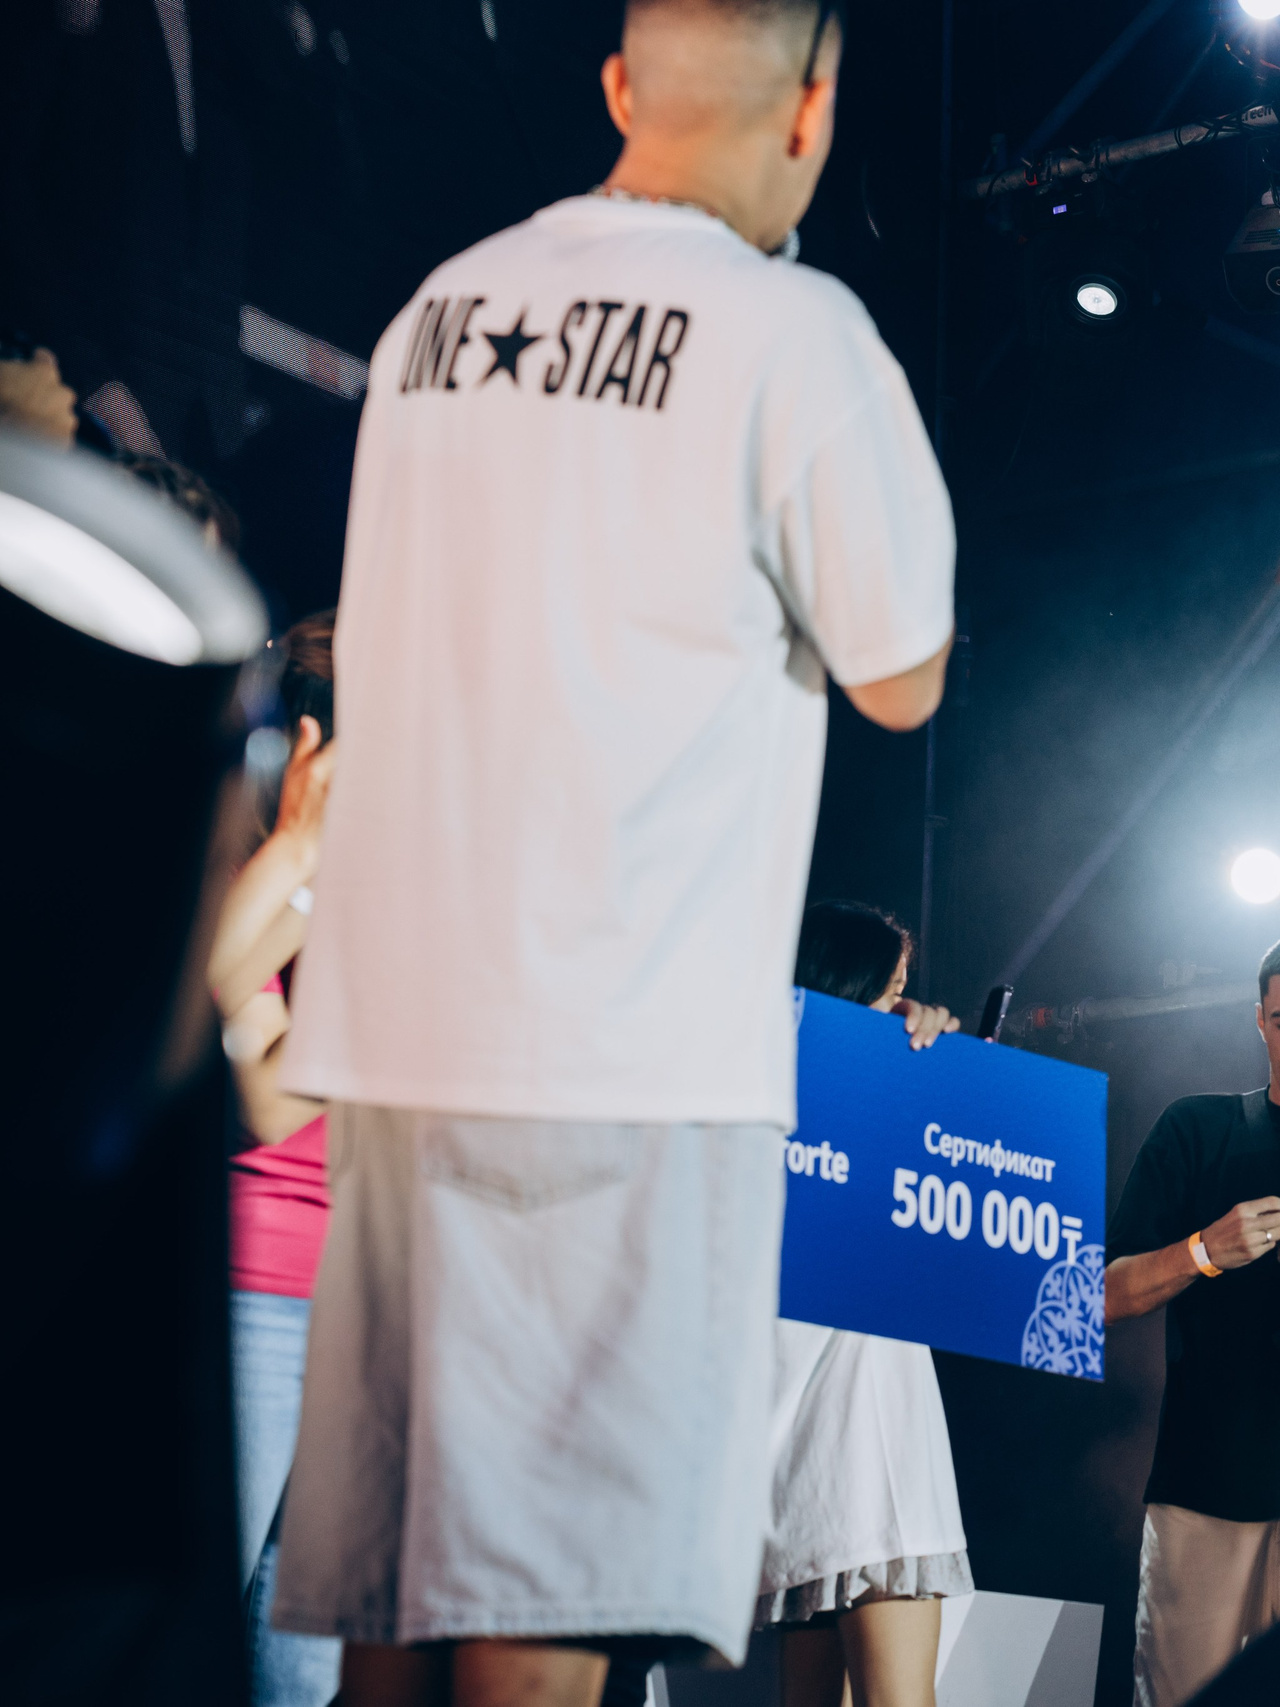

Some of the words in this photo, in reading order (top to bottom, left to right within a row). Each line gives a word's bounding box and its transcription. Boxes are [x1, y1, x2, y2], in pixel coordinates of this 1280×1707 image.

[543, 300, 690, 411] STAR
[923, 1122, 1056, 1182] Сертификат
[891, 1167, 972, 1241] 500
